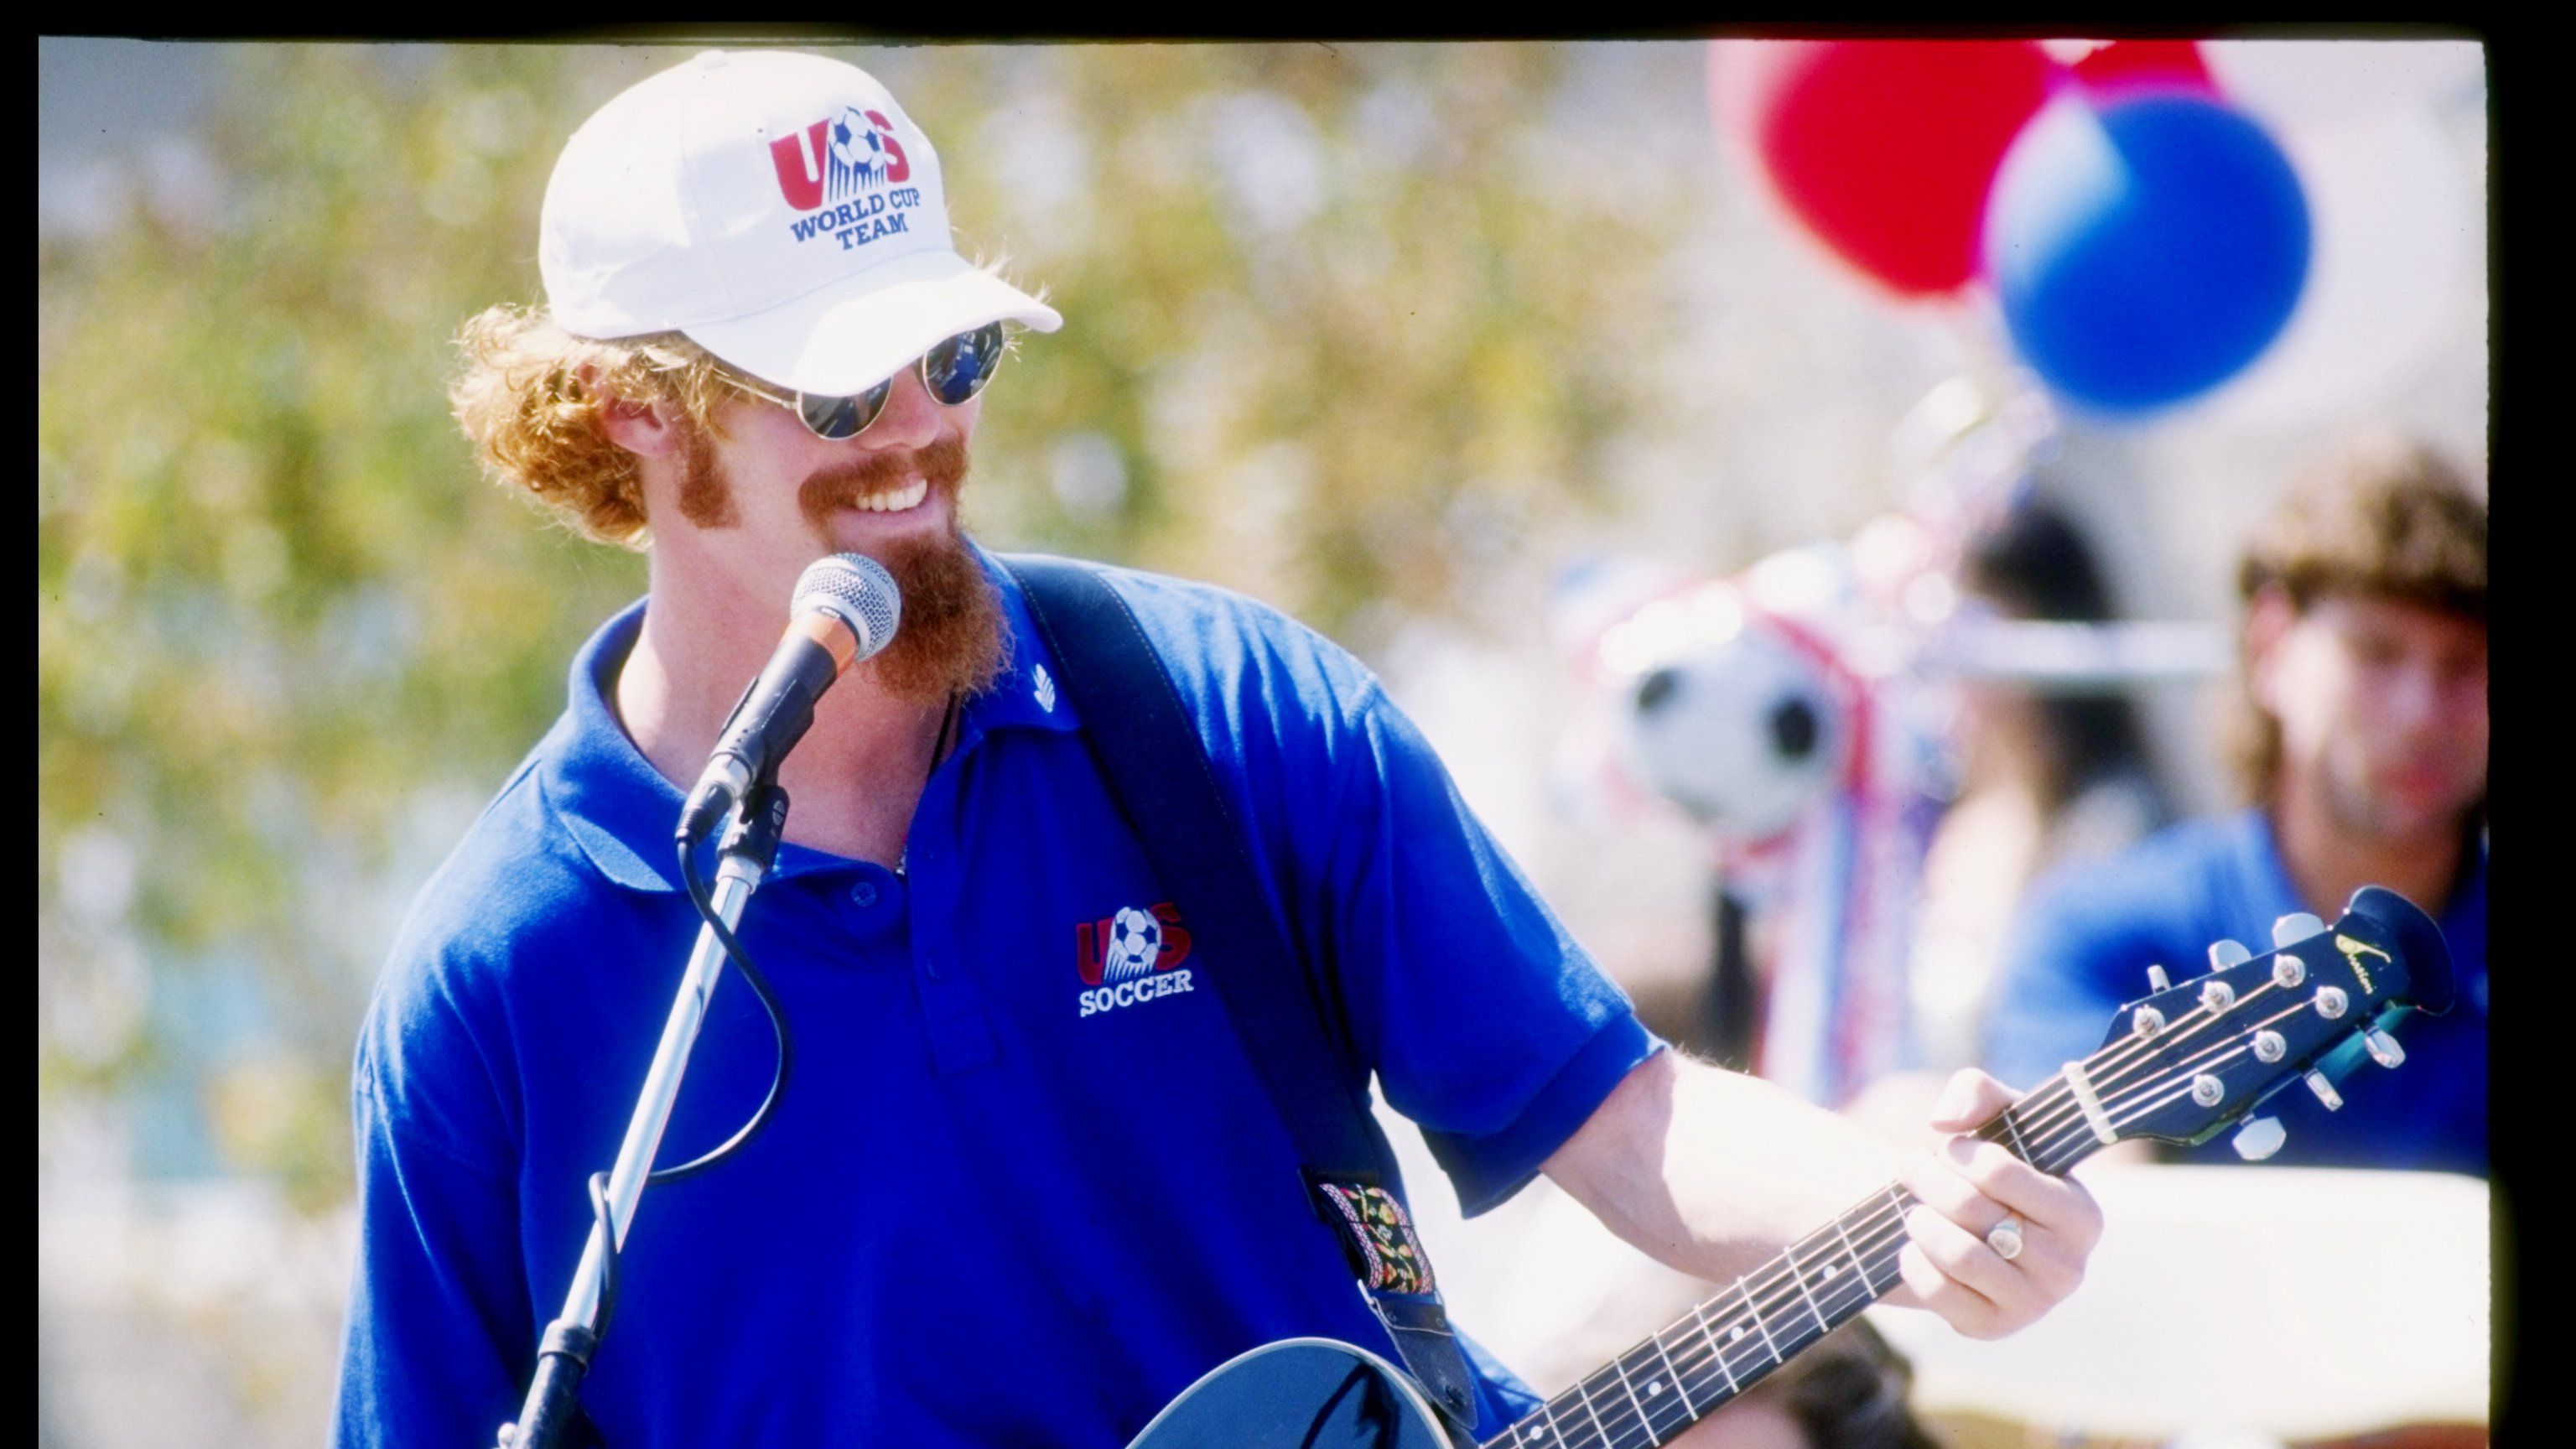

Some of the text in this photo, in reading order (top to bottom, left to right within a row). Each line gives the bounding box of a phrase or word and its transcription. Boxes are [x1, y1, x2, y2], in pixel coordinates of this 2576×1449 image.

[790, 187, 920, 242] WORLD CUP
[835, 212, 908, 250] TEAM
[1079, 969, 1194, 1018] SOCCER
